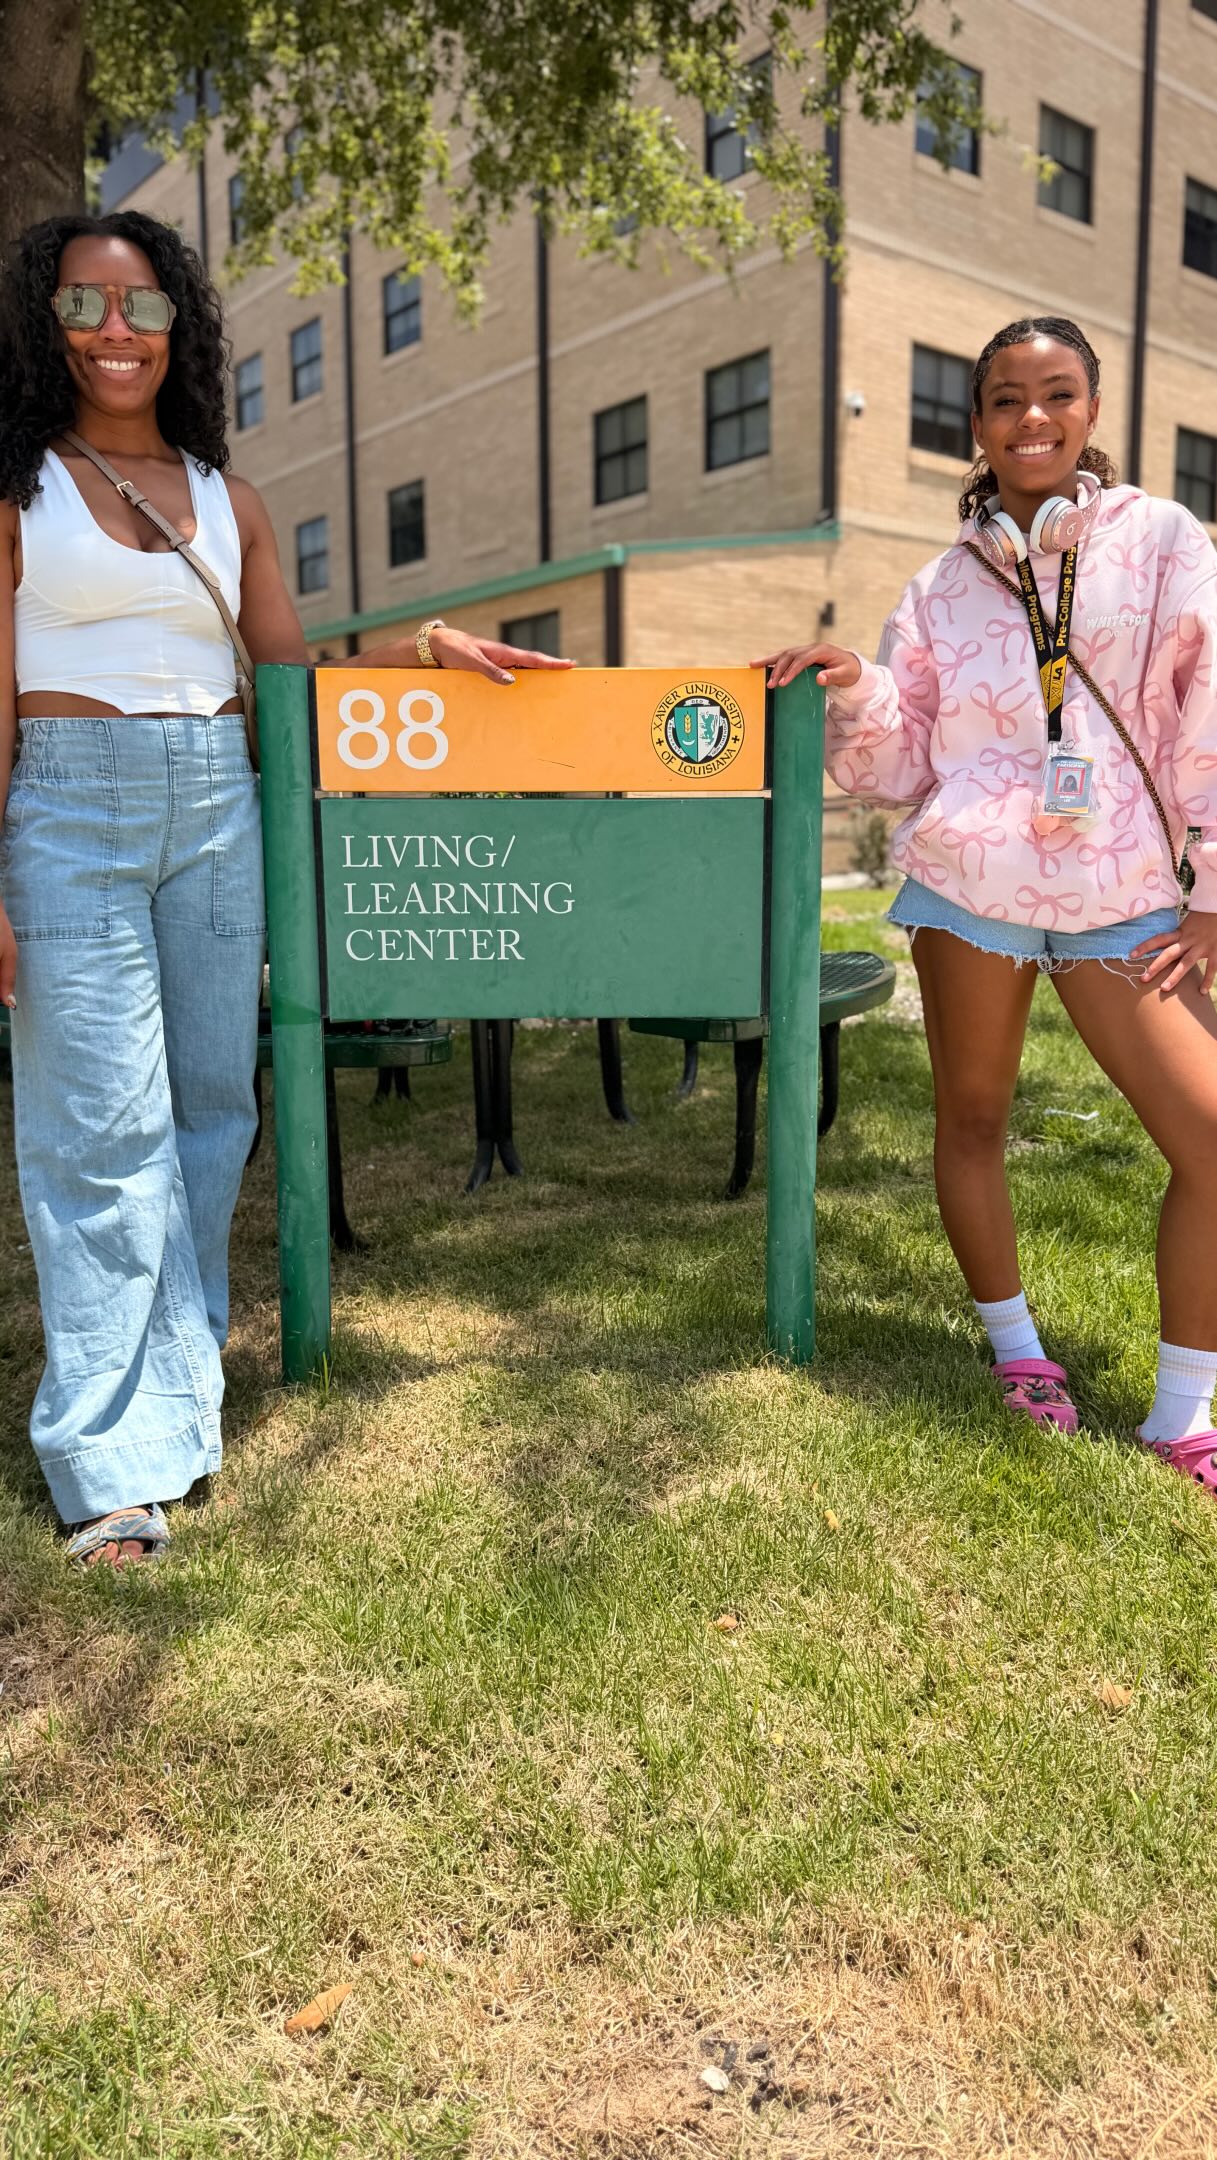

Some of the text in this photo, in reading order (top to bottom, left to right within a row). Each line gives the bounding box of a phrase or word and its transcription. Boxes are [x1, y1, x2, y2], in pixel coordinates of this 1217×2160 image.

[1027, 594, 1046, 651] Programs
[1056, 577, 1073, 647] Pre-College
[1087, 612, 1151, 630] WHITE FOX
[653, 684, 742, 731] XAVIER UNIVERSITY
[337, 689, 449, 770] 88
[661, 748, 736, 775] OF LOUISIANA
[341, 834, 516, 868] LIVING/
[343, 881, 576, 915] LEARNING
[345, 928, 526, 962] CENTER
